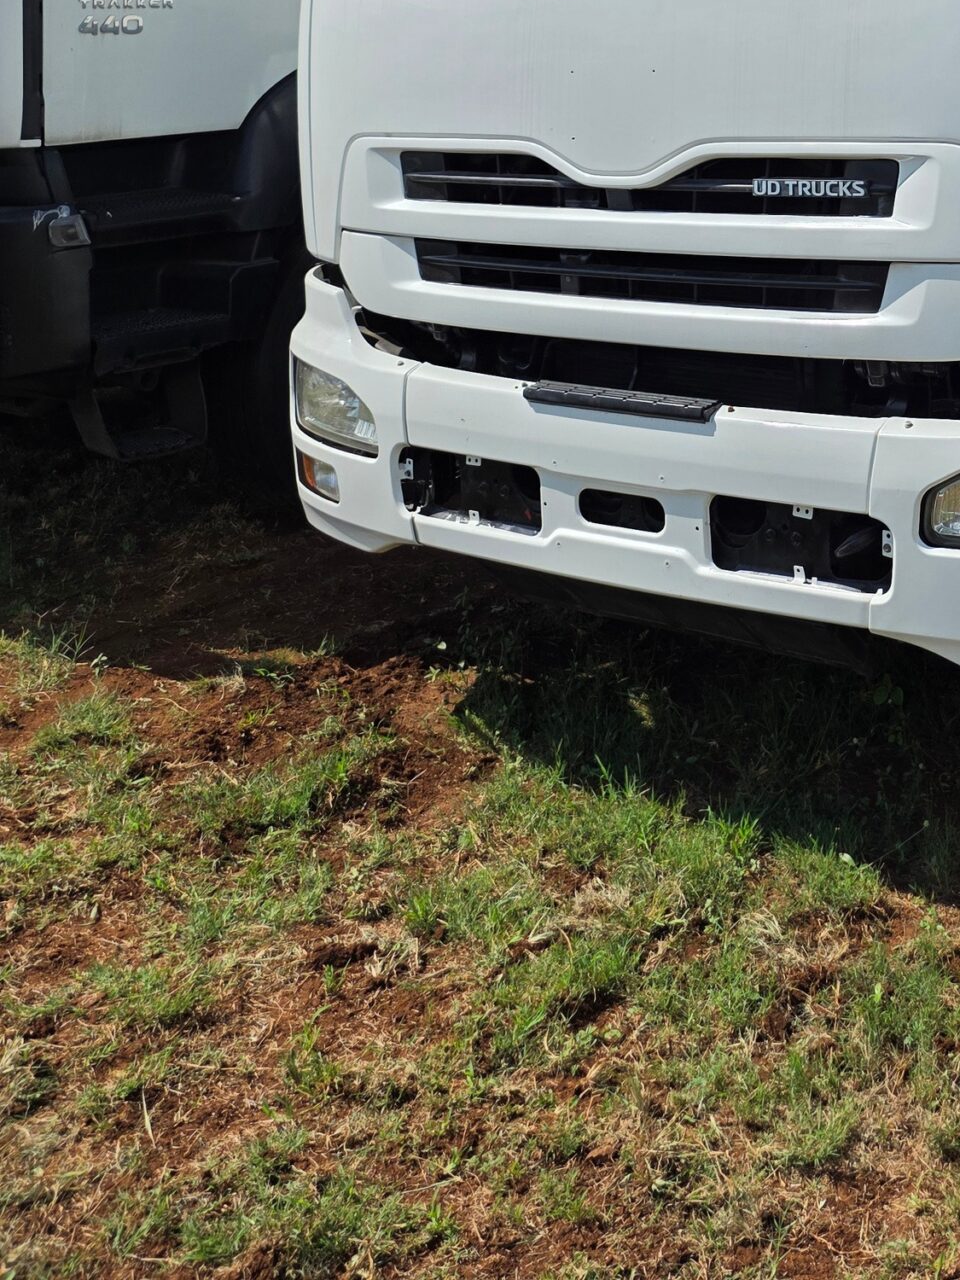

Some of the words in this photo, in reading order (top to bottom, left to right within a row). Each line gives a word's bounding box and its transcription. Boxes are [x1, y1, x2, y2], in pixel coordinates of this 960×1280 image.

[78, 15, 144, 36] 440
[754, 180, 780, 195] UD
[784, 180, 865, 197] TRUCKS
